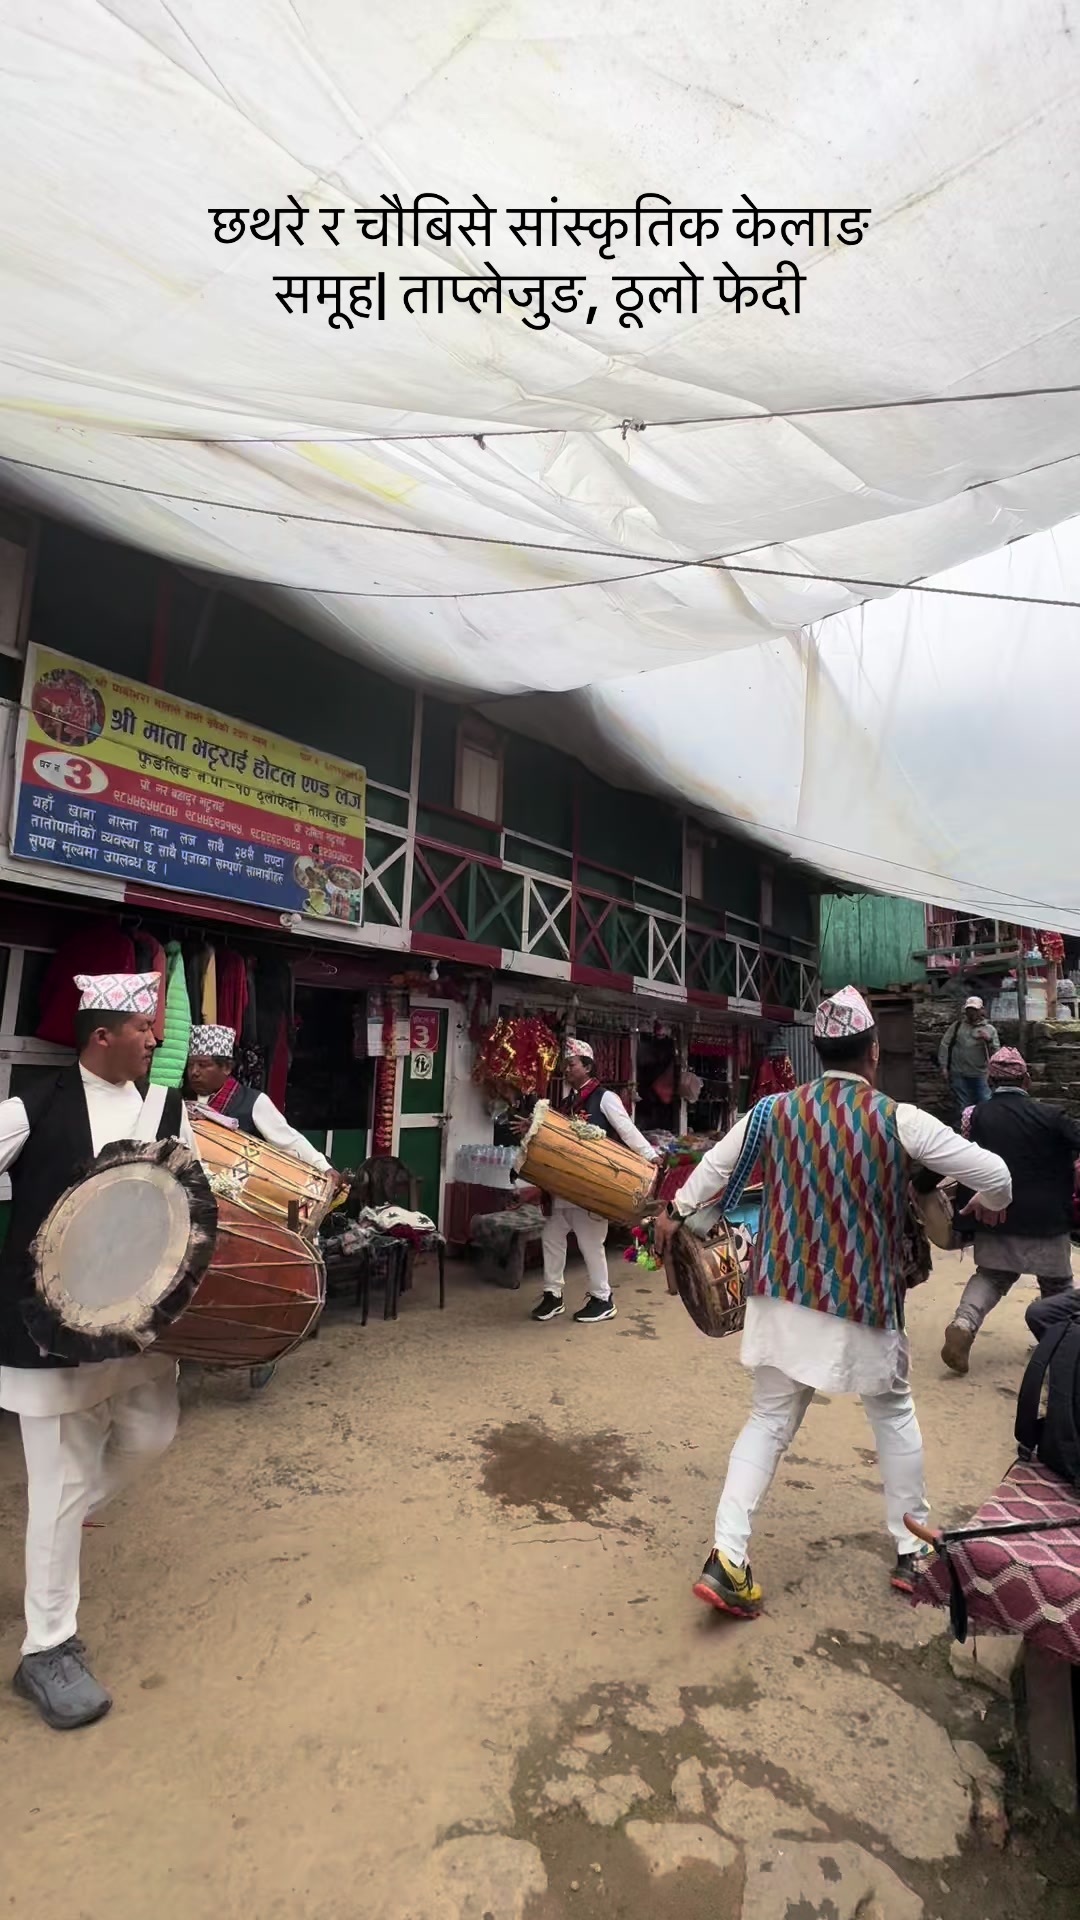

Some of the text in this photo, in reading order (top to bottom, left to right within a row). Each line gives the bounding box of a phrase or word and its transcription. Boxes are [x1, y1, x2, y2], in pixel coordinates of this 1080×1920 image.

[111, 706, 138, 735] श्री
[143, 719, 188, 751] माता
[253, 754, 297, 788] होटल
[301, 774, 331, 799] एण्ड
[335, 785, 362, 809] लज
[28, 833, 57, 852] सुपथ
[62, 840, 100, 860] मूल्यमा
[103, 849, 143, 869] उपलब्ध
[147, 859, 158, 875] छ
[31, 814, 97, 840] तातोपानीको
[100, 830, 140, 850] व्यवस्था
[143, 840, 154, 856] छ
[158, 842, 178, 859] साथै
[32, 792, 55, 814] यहाँ
[68, 803, 97, 821] खाना
[108, 813, 139, 832] नास्ता
[149, 824, 169, 840] तथा
[179, 832, 198, 847] लज
[207, 836, 225, 853] साथै
[263, 853, 285, 869] घण्टा
